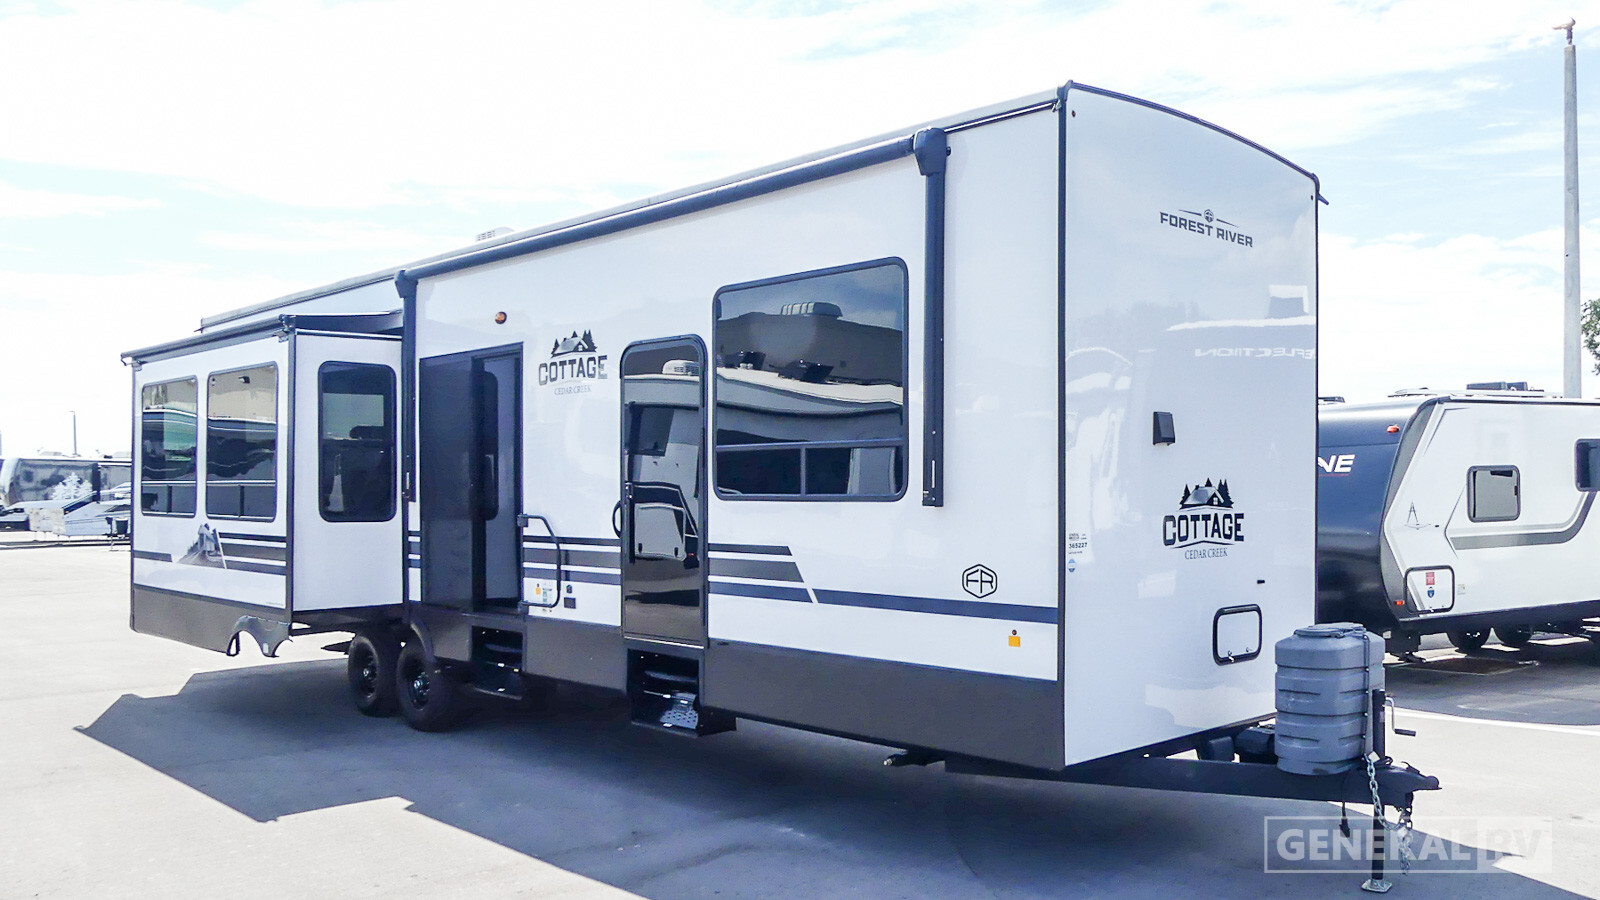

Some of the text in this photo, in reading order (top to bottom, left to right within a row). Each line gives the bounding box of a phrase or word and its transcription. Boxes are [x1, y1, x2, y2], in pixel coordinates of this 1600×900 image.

[1160, 212, 1253, 247] FOREST RIVER
[538, 355, 608, 386] COTTAGE
[554, 385, 592, 395] CEDAR CREEK
[1163, 512, 1245, 546] COTTAGE
[1185, 547, 1228, 560] CEDAR CREEK
